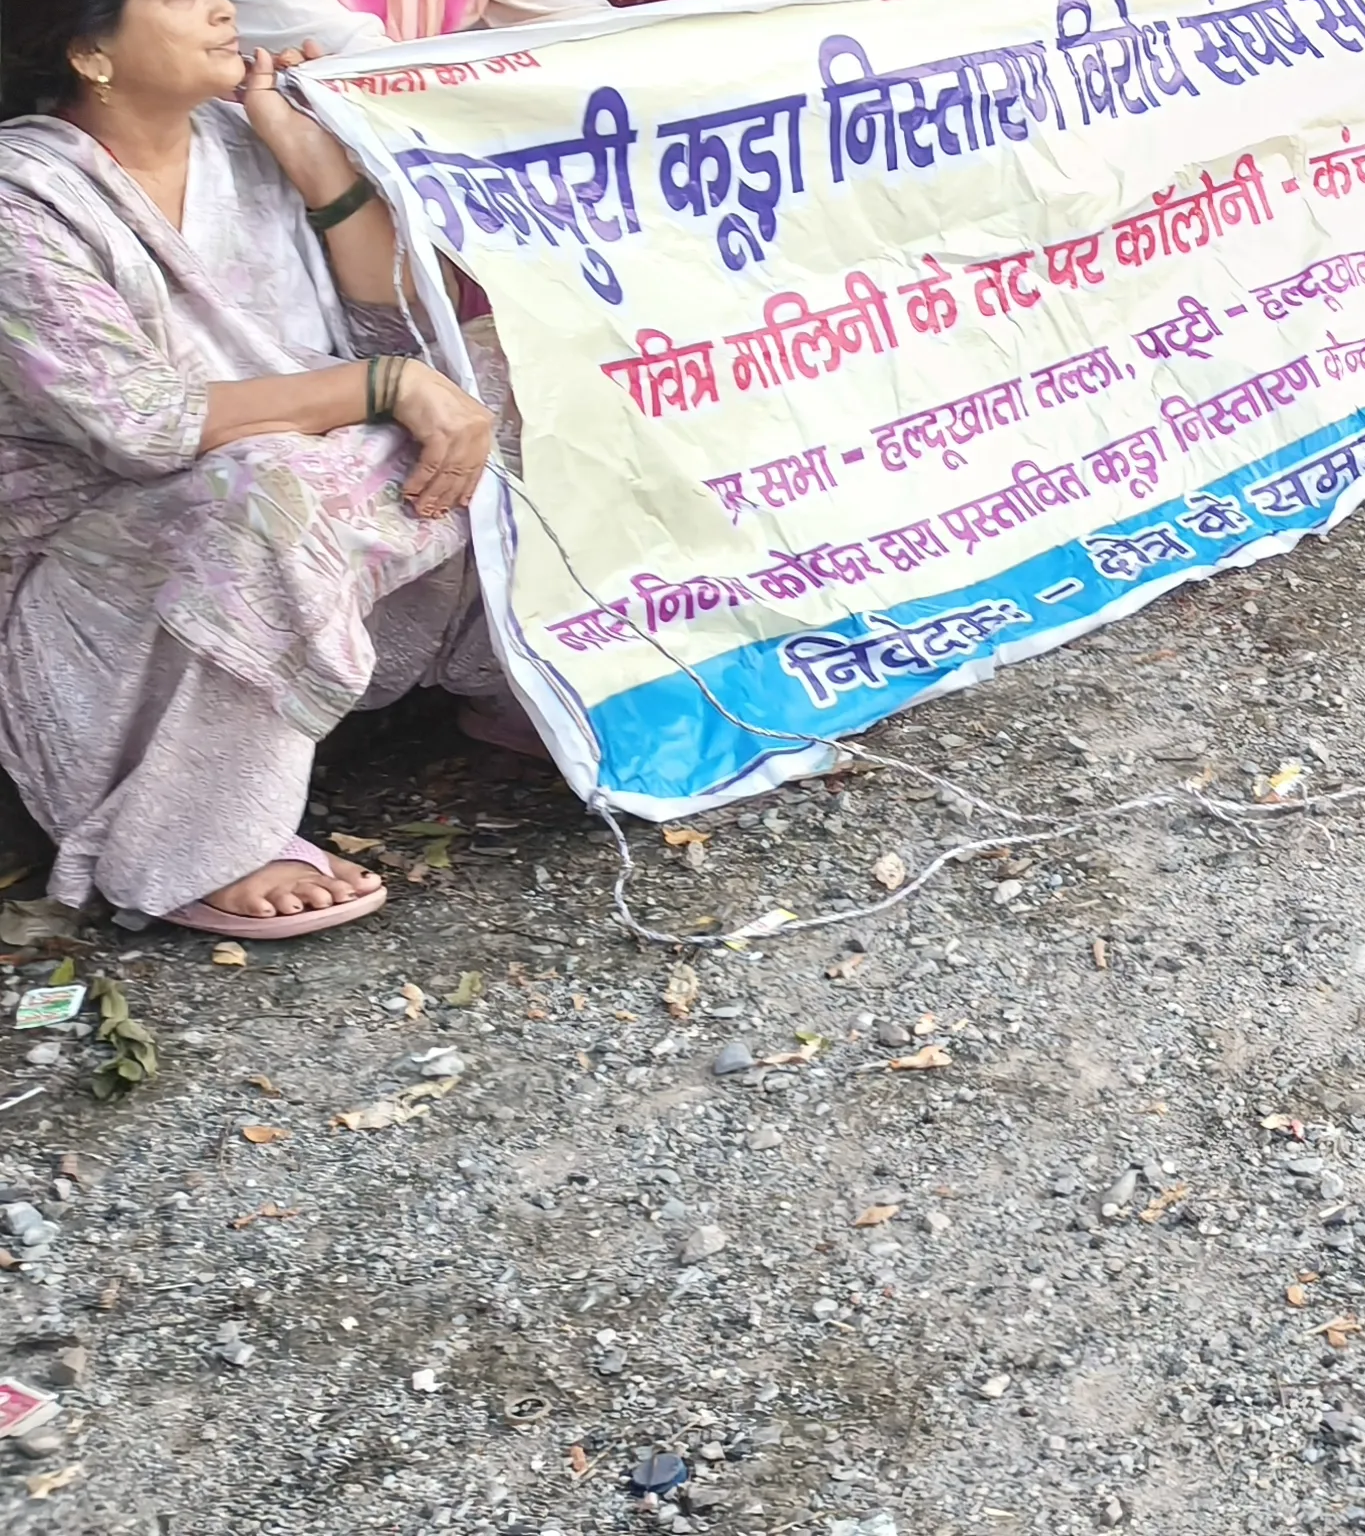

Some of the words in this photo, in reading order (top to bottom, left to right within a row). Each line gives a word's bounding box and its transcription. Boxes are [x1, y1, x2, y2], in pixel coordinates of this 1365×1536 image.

[656, 93, 807, 271] कूड़ा
[818, 34, 1067, 183] निस्तारण
[722, 271, 899, 390] मालिनी
[897, 253, 958, 334] के
[963, 251, 1041, 317] तट
[1043, 231, 1105, 289] पर
[1112, 153, 1273, 267] कॉलोनी
[749, 445, 838, 507] सभा
[868, 518, 950, 571] द्वारा
[937, 459, 1092, 555] प्रस्तावित
[1160, 355, 1321, 453] निस्तारण
[1182, 495, 1248, 533] के
